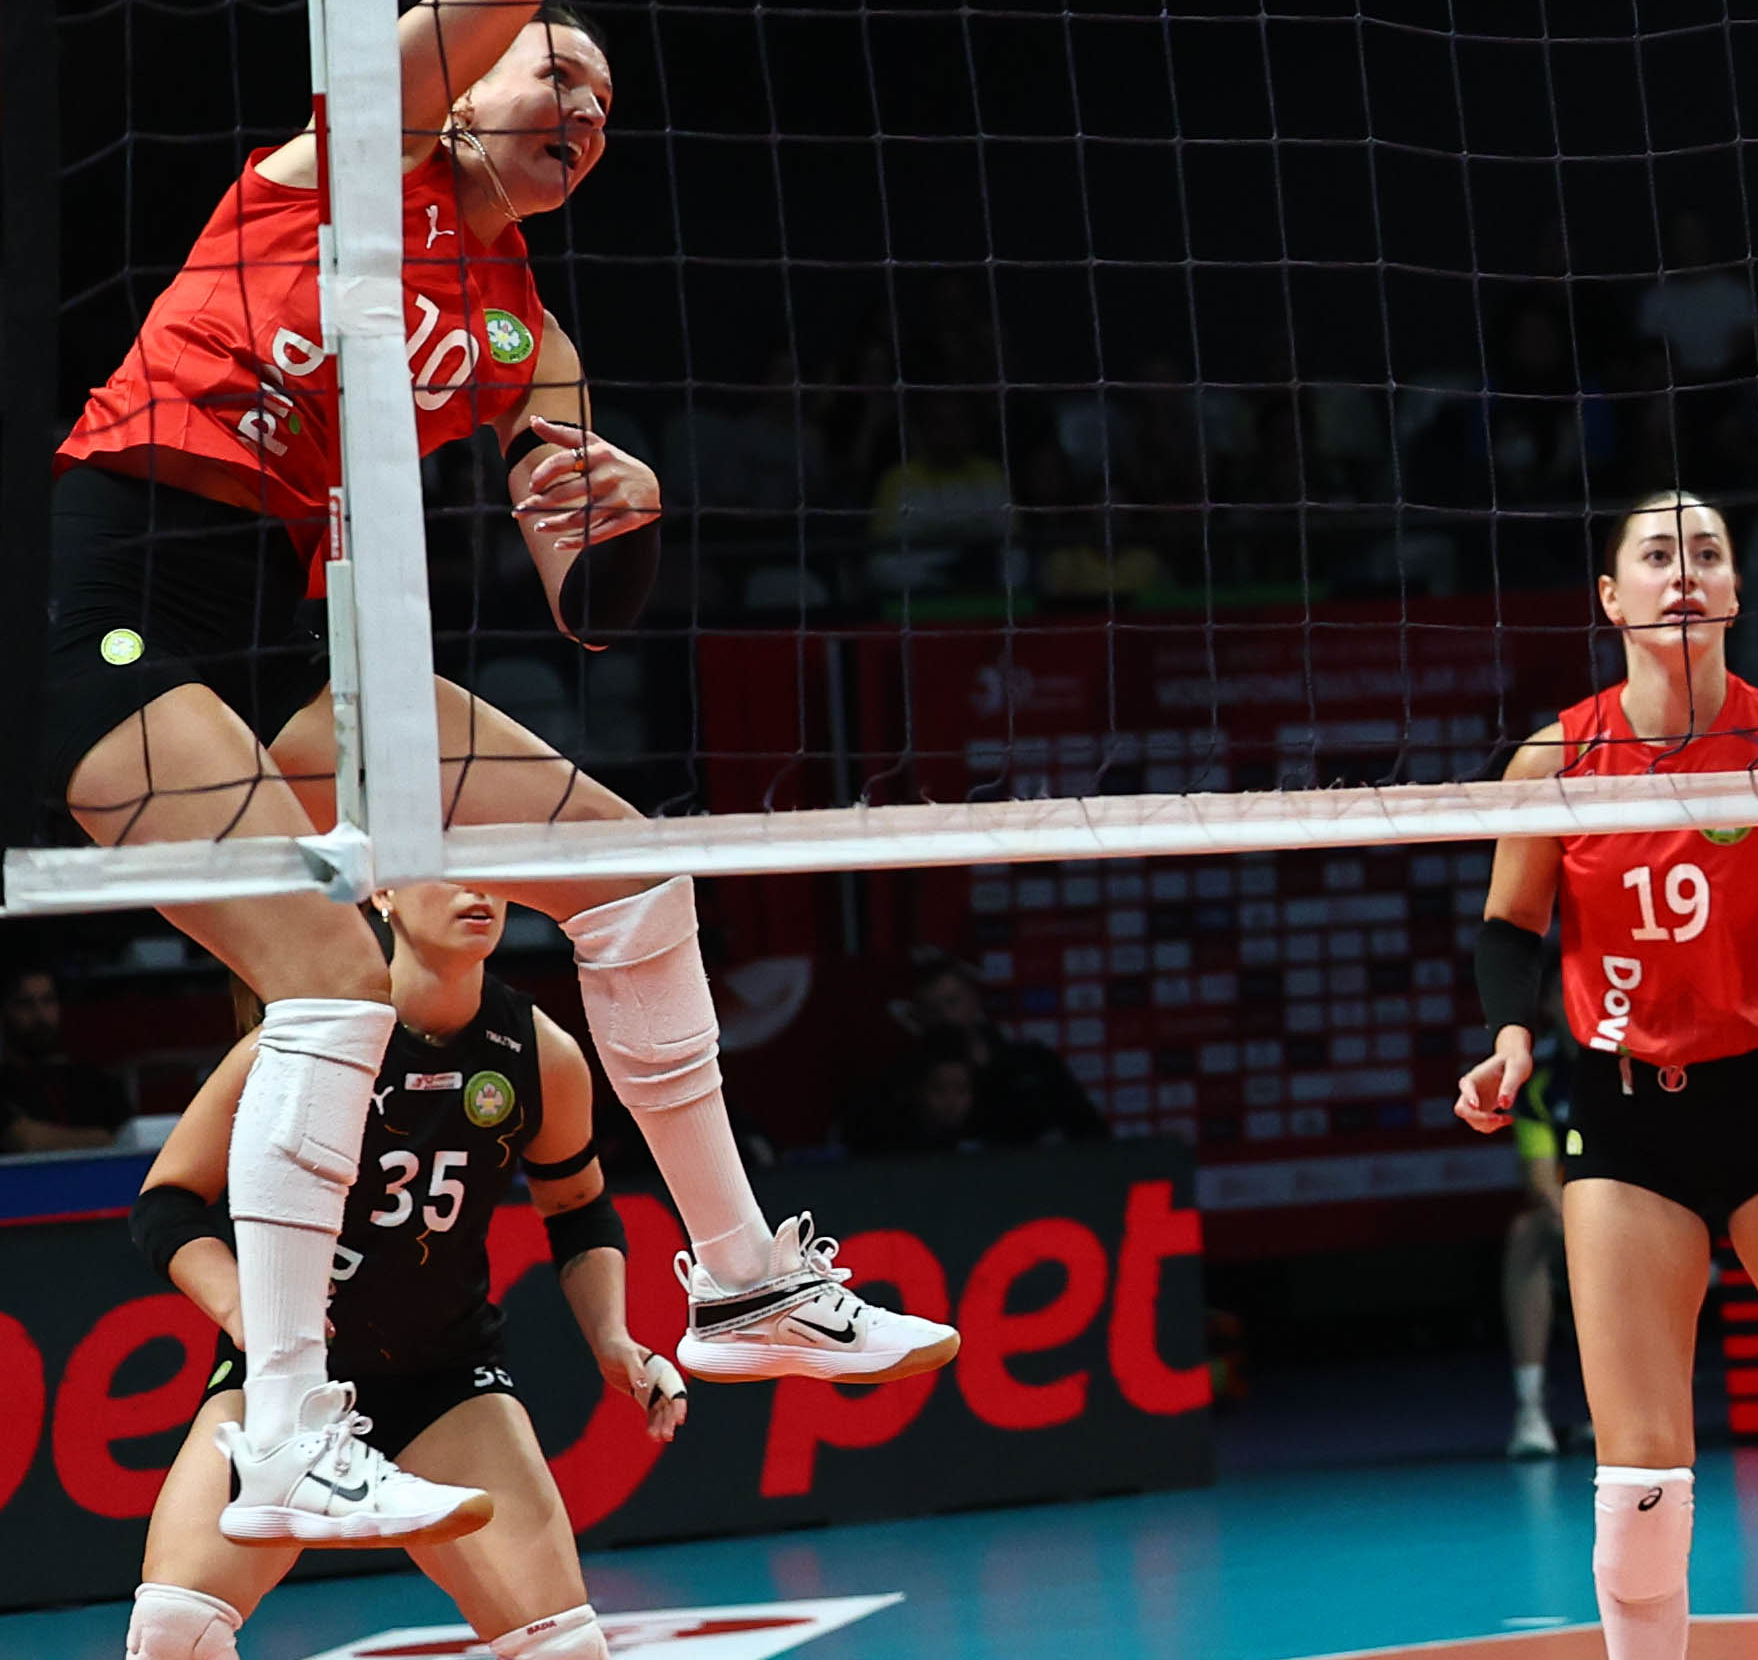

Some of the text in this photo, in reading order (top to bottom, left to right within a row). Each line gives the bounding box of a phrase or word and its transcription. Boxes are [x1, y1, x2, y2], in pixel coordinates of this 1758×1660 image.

[407, 294, 478, 411] 10
[1623, 864, 1710, 943] 19
[370, 1151, 468, 1232] 35
